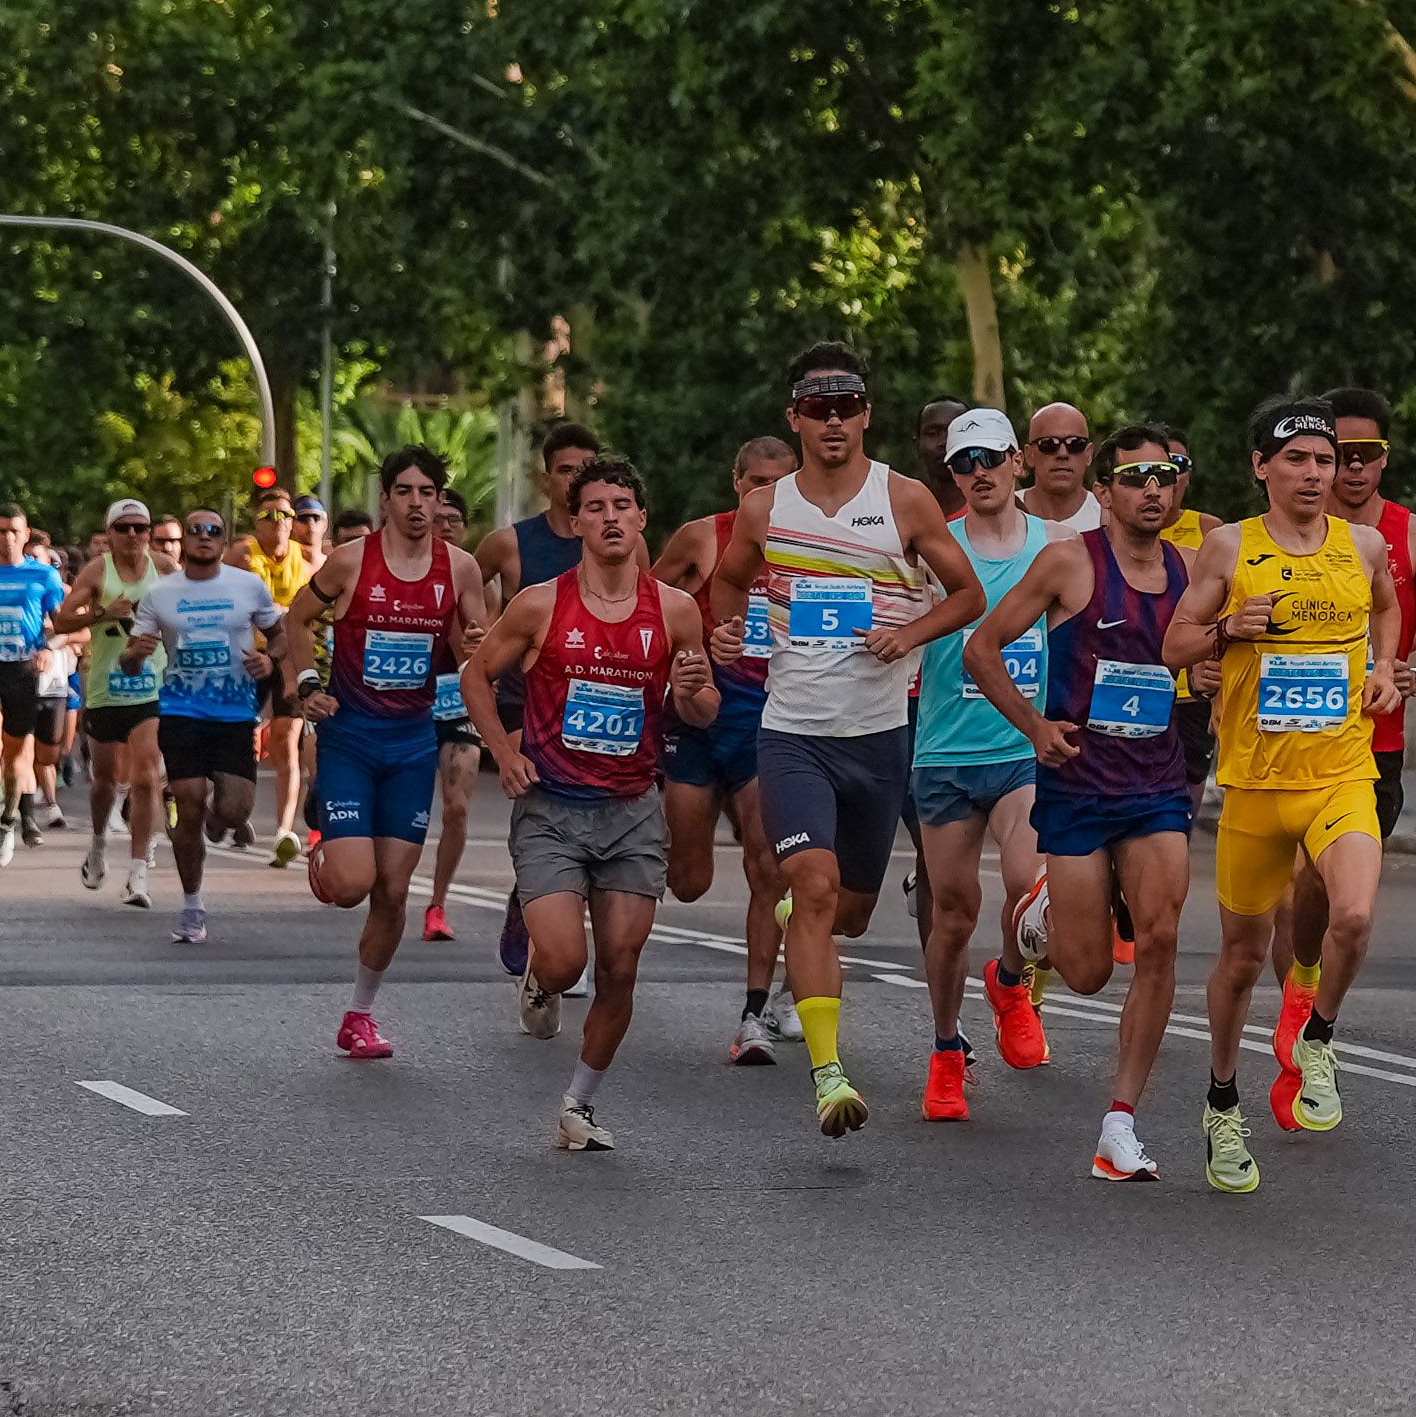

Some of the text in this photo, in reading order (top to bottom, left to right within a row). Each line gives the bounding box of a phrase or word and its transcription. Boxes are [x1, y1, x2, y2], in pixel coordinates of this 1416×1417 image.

[851, 515, 885, 527] HOKA
[1291, 599, 1337, 611] CLÍNICA
[389, 616, 445, 627] MARATHON
[821, 609, 839, 631] 5
[1291, 611, 1354, 622] MENORCA
[367, 655, 427, 675] 2426
[589, 666, 653, 680] MARATHON
[1122, 695, 1140, 717] 4
[1264, 685, 1344, 710] 2656
[567, 709, 638, 736] 4201
[329, 811, 360, 822] ADM
[775, 832, 811, 854] HOKA
